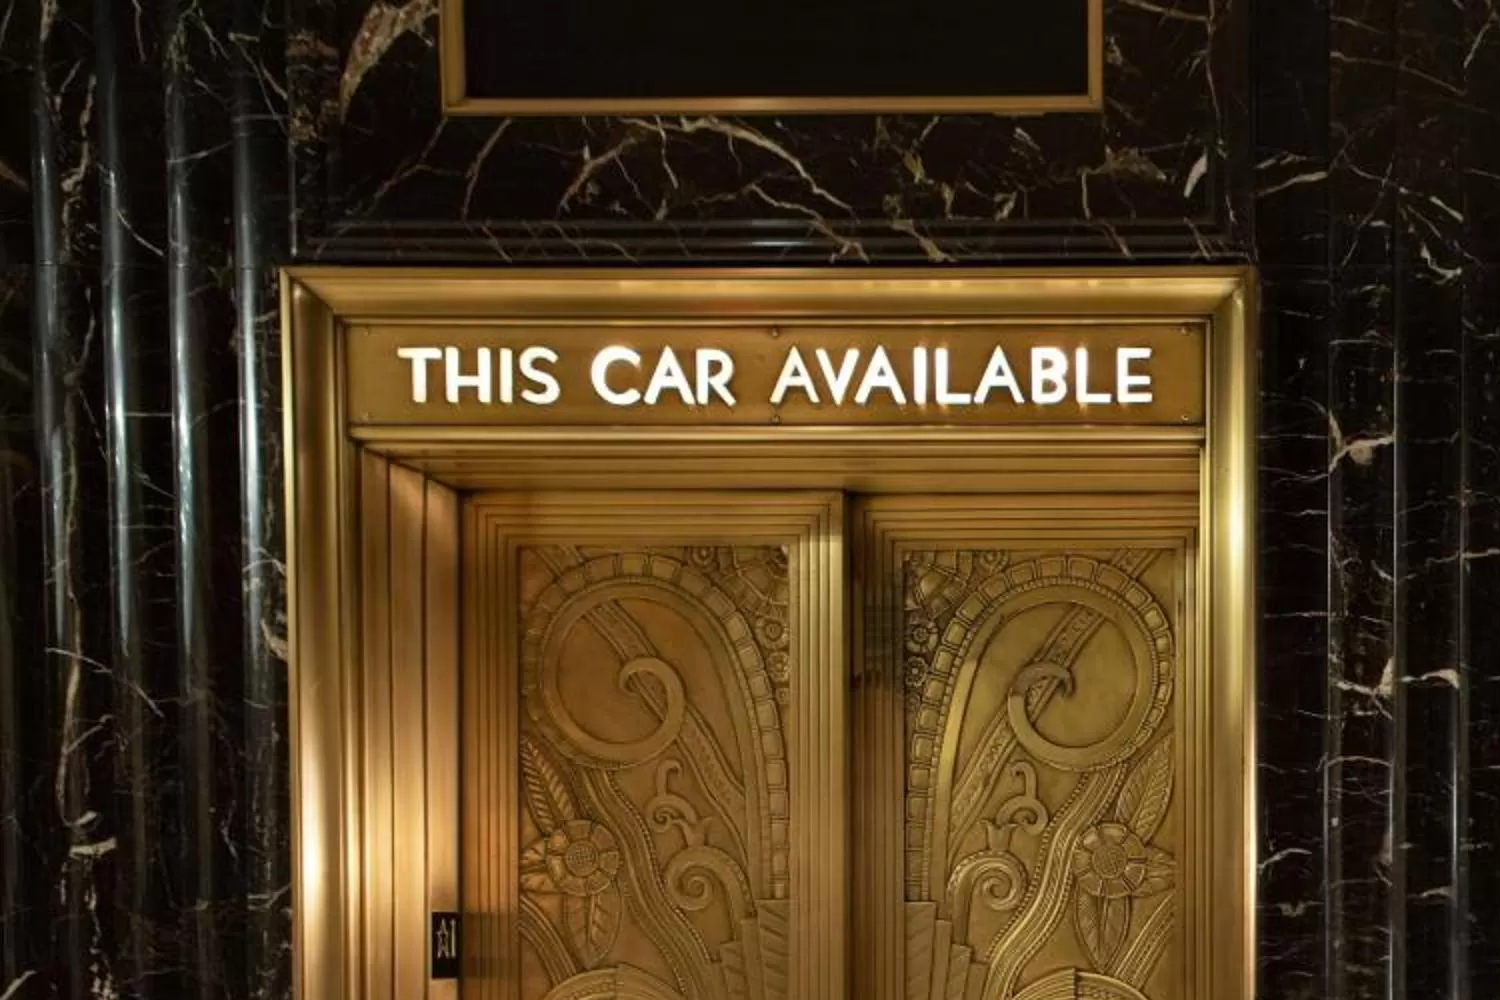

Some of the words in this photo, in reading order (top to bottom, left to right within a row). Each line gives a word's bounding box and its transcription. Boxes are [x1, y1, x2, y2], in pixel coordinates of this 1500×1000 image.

[397, 346, 561, 404] THIS
[590, 344, 736, 406] CAR
[769, 344, 1153, 406] AVAILABLE
